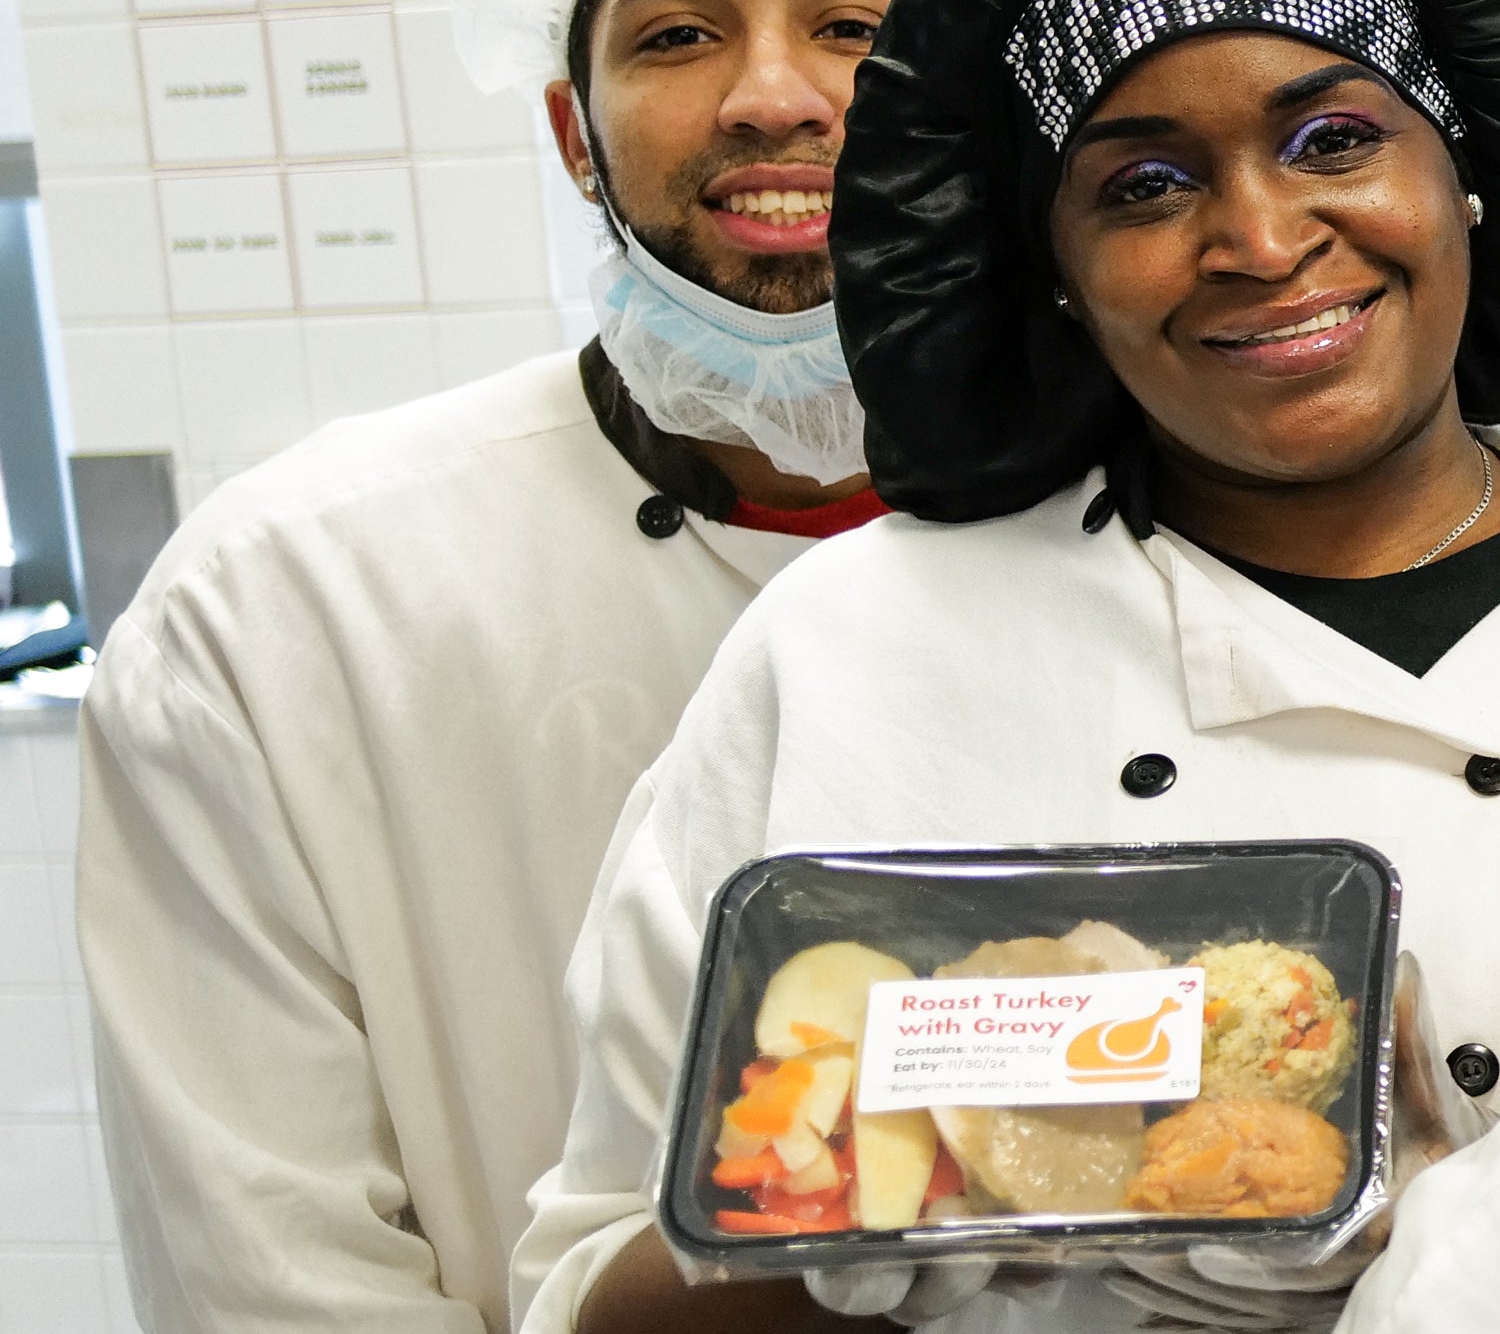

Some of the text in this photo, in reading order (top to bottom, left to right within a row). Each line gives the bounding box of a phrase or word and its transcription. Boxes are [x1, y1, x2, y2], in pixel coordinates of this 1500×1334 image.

[901, 991, 1093, 1013] Roast Turkey
[898, 1017, 1064, 1039] with Gravy
[894, 1045, 967, 1057] Contains:
[1027, 1044, 1054, 1055] Soy
[893, 1062, 916, 1073] Eat
[920, 1060, 944, 1073] by:
